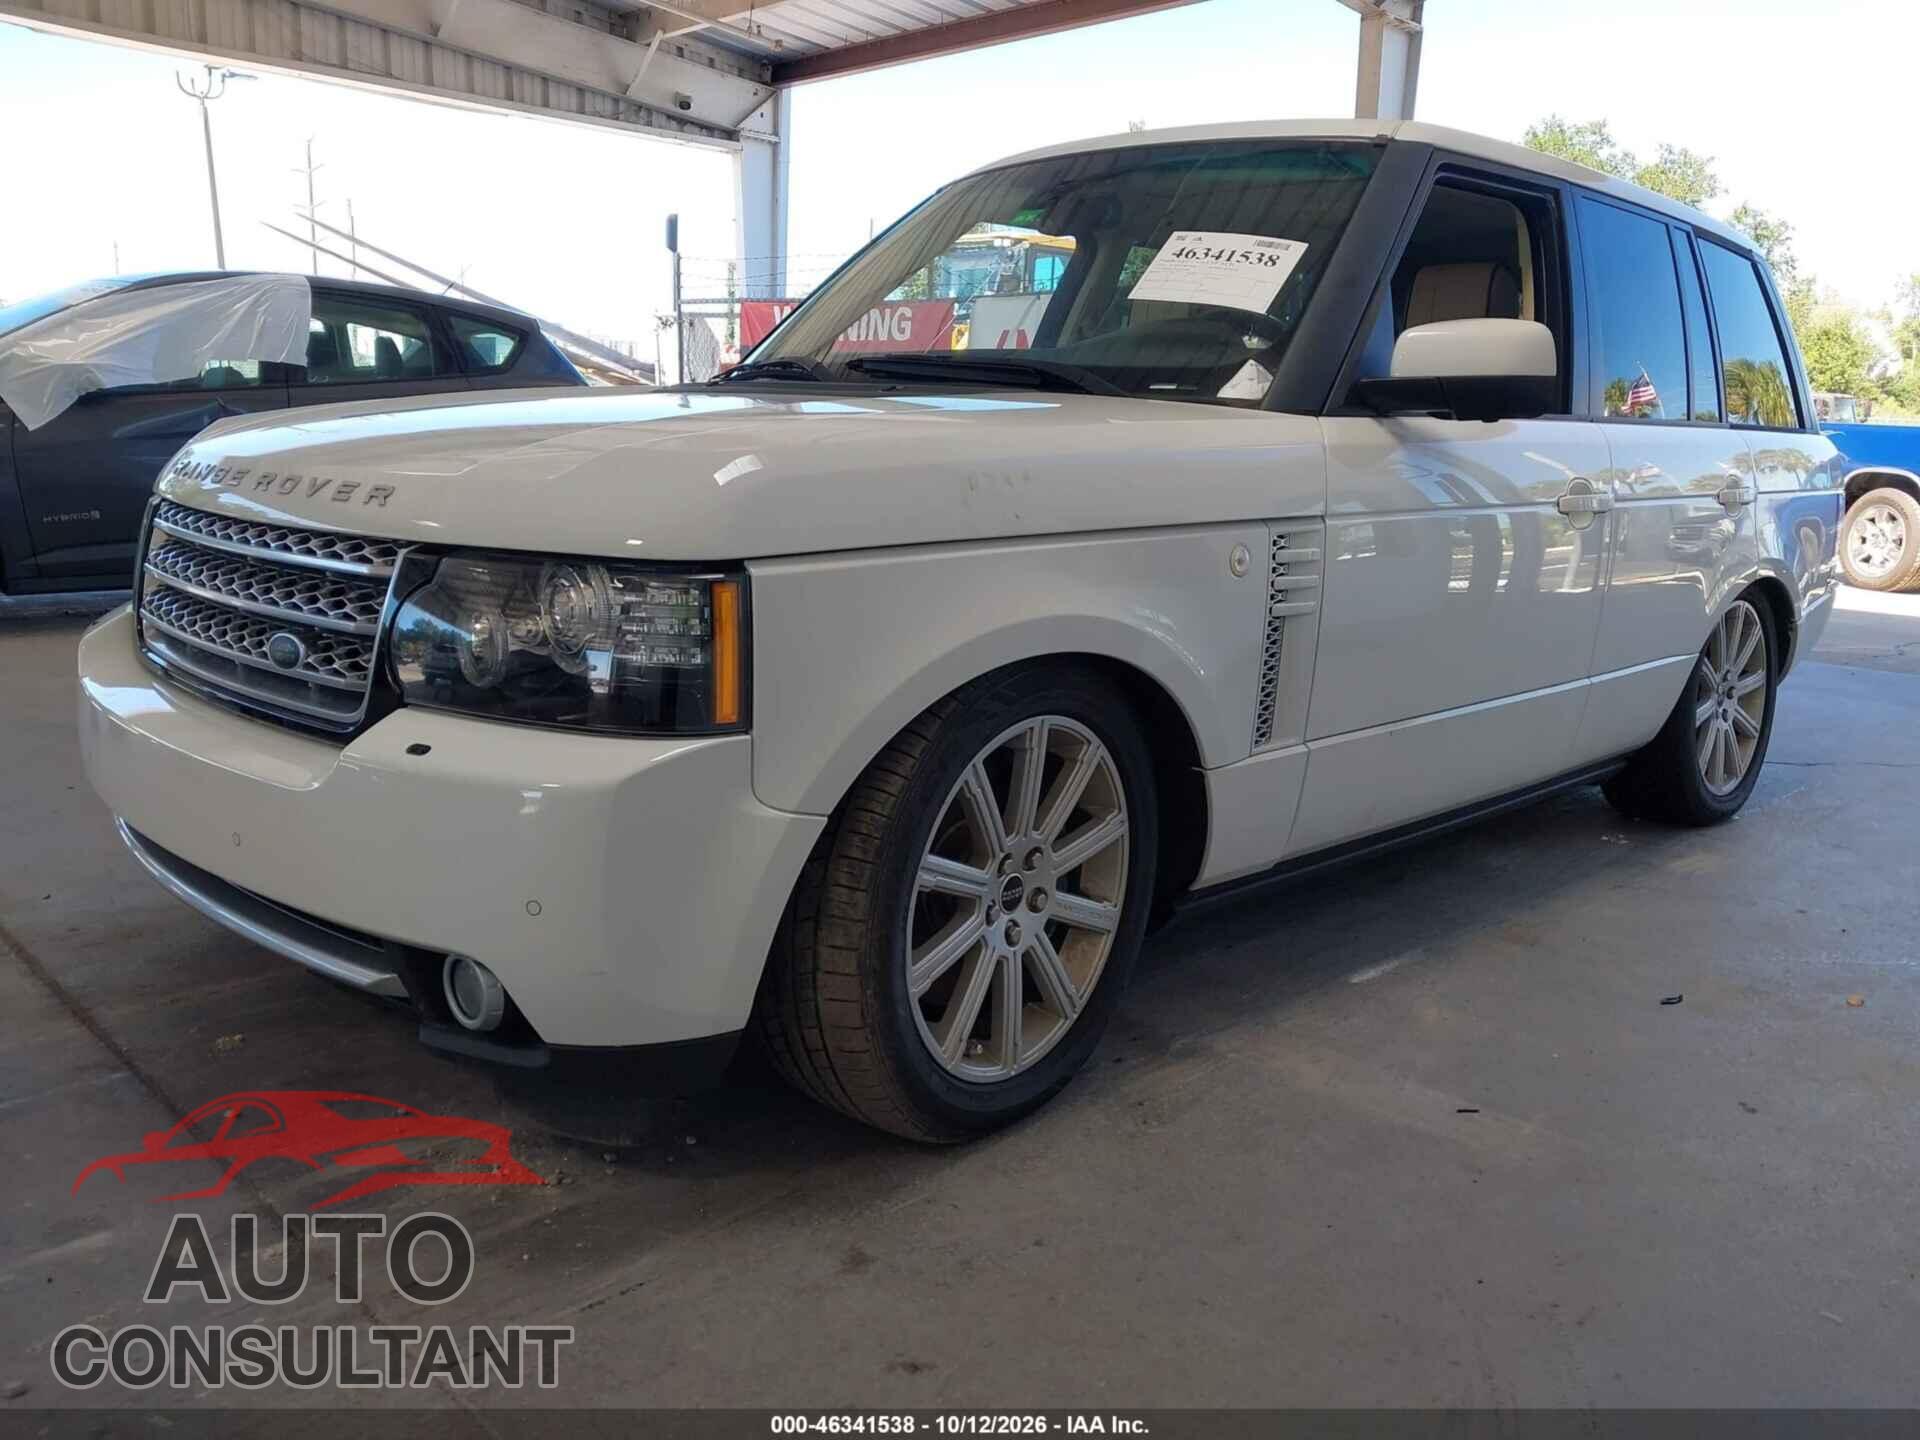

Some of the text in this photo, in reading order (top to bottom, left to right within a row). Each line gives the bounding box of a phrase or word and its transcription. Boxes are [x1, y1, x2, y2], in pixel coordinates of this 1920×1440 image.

[1171, 246, 1281, 268] 46341538
[773, 304, 913, 342] WNING
[174, 460, 397, 508] RANGE ROVER
